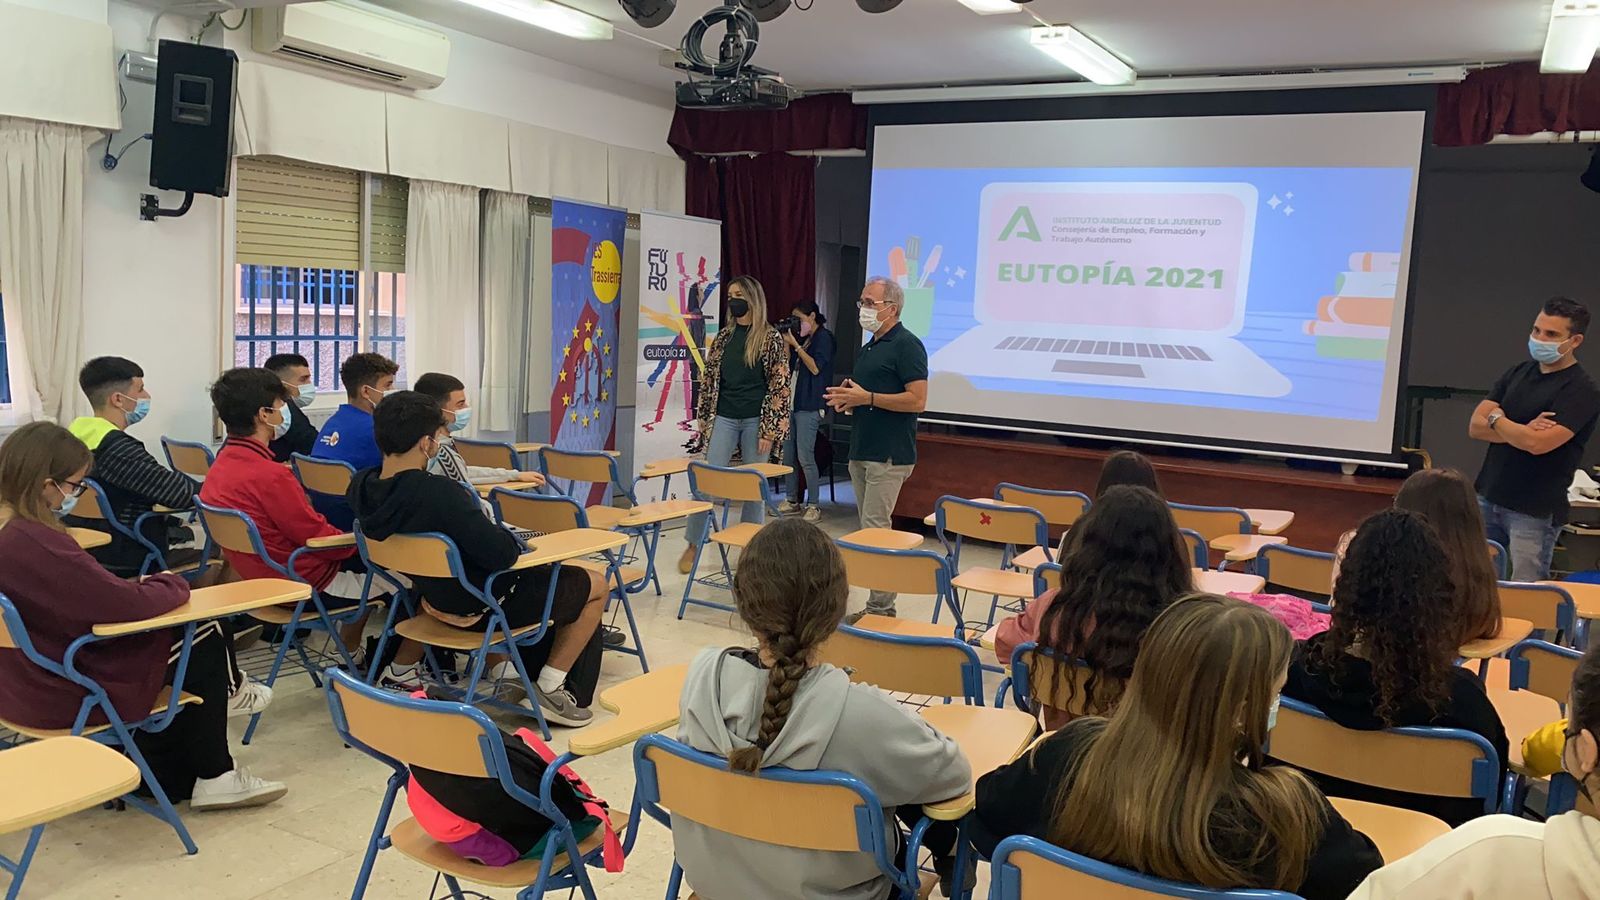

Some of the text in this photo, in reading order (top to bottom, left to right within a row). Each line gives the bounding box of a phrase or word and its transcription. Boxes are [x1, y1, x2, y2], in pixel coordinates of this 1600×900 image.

[1052, 216, 1099, 225] INSTITUTO
[1100, 217, 1142, 225] ANDALUZ
[1144, 217, 1156, 225] DE
[1171, 218, 1222, 226] JUVENTUD
[1111, 227, 1147, 235] Empleo,
[1149, 227, 1198, 236] Formación
[1199, 229, 1206, 237] y
[1051, 235, 1132, 244] Trabajo Autónomo
[997, 260, 1224, 290] EUTOPÍA 2021
[679, 348, 686, 357] 21
